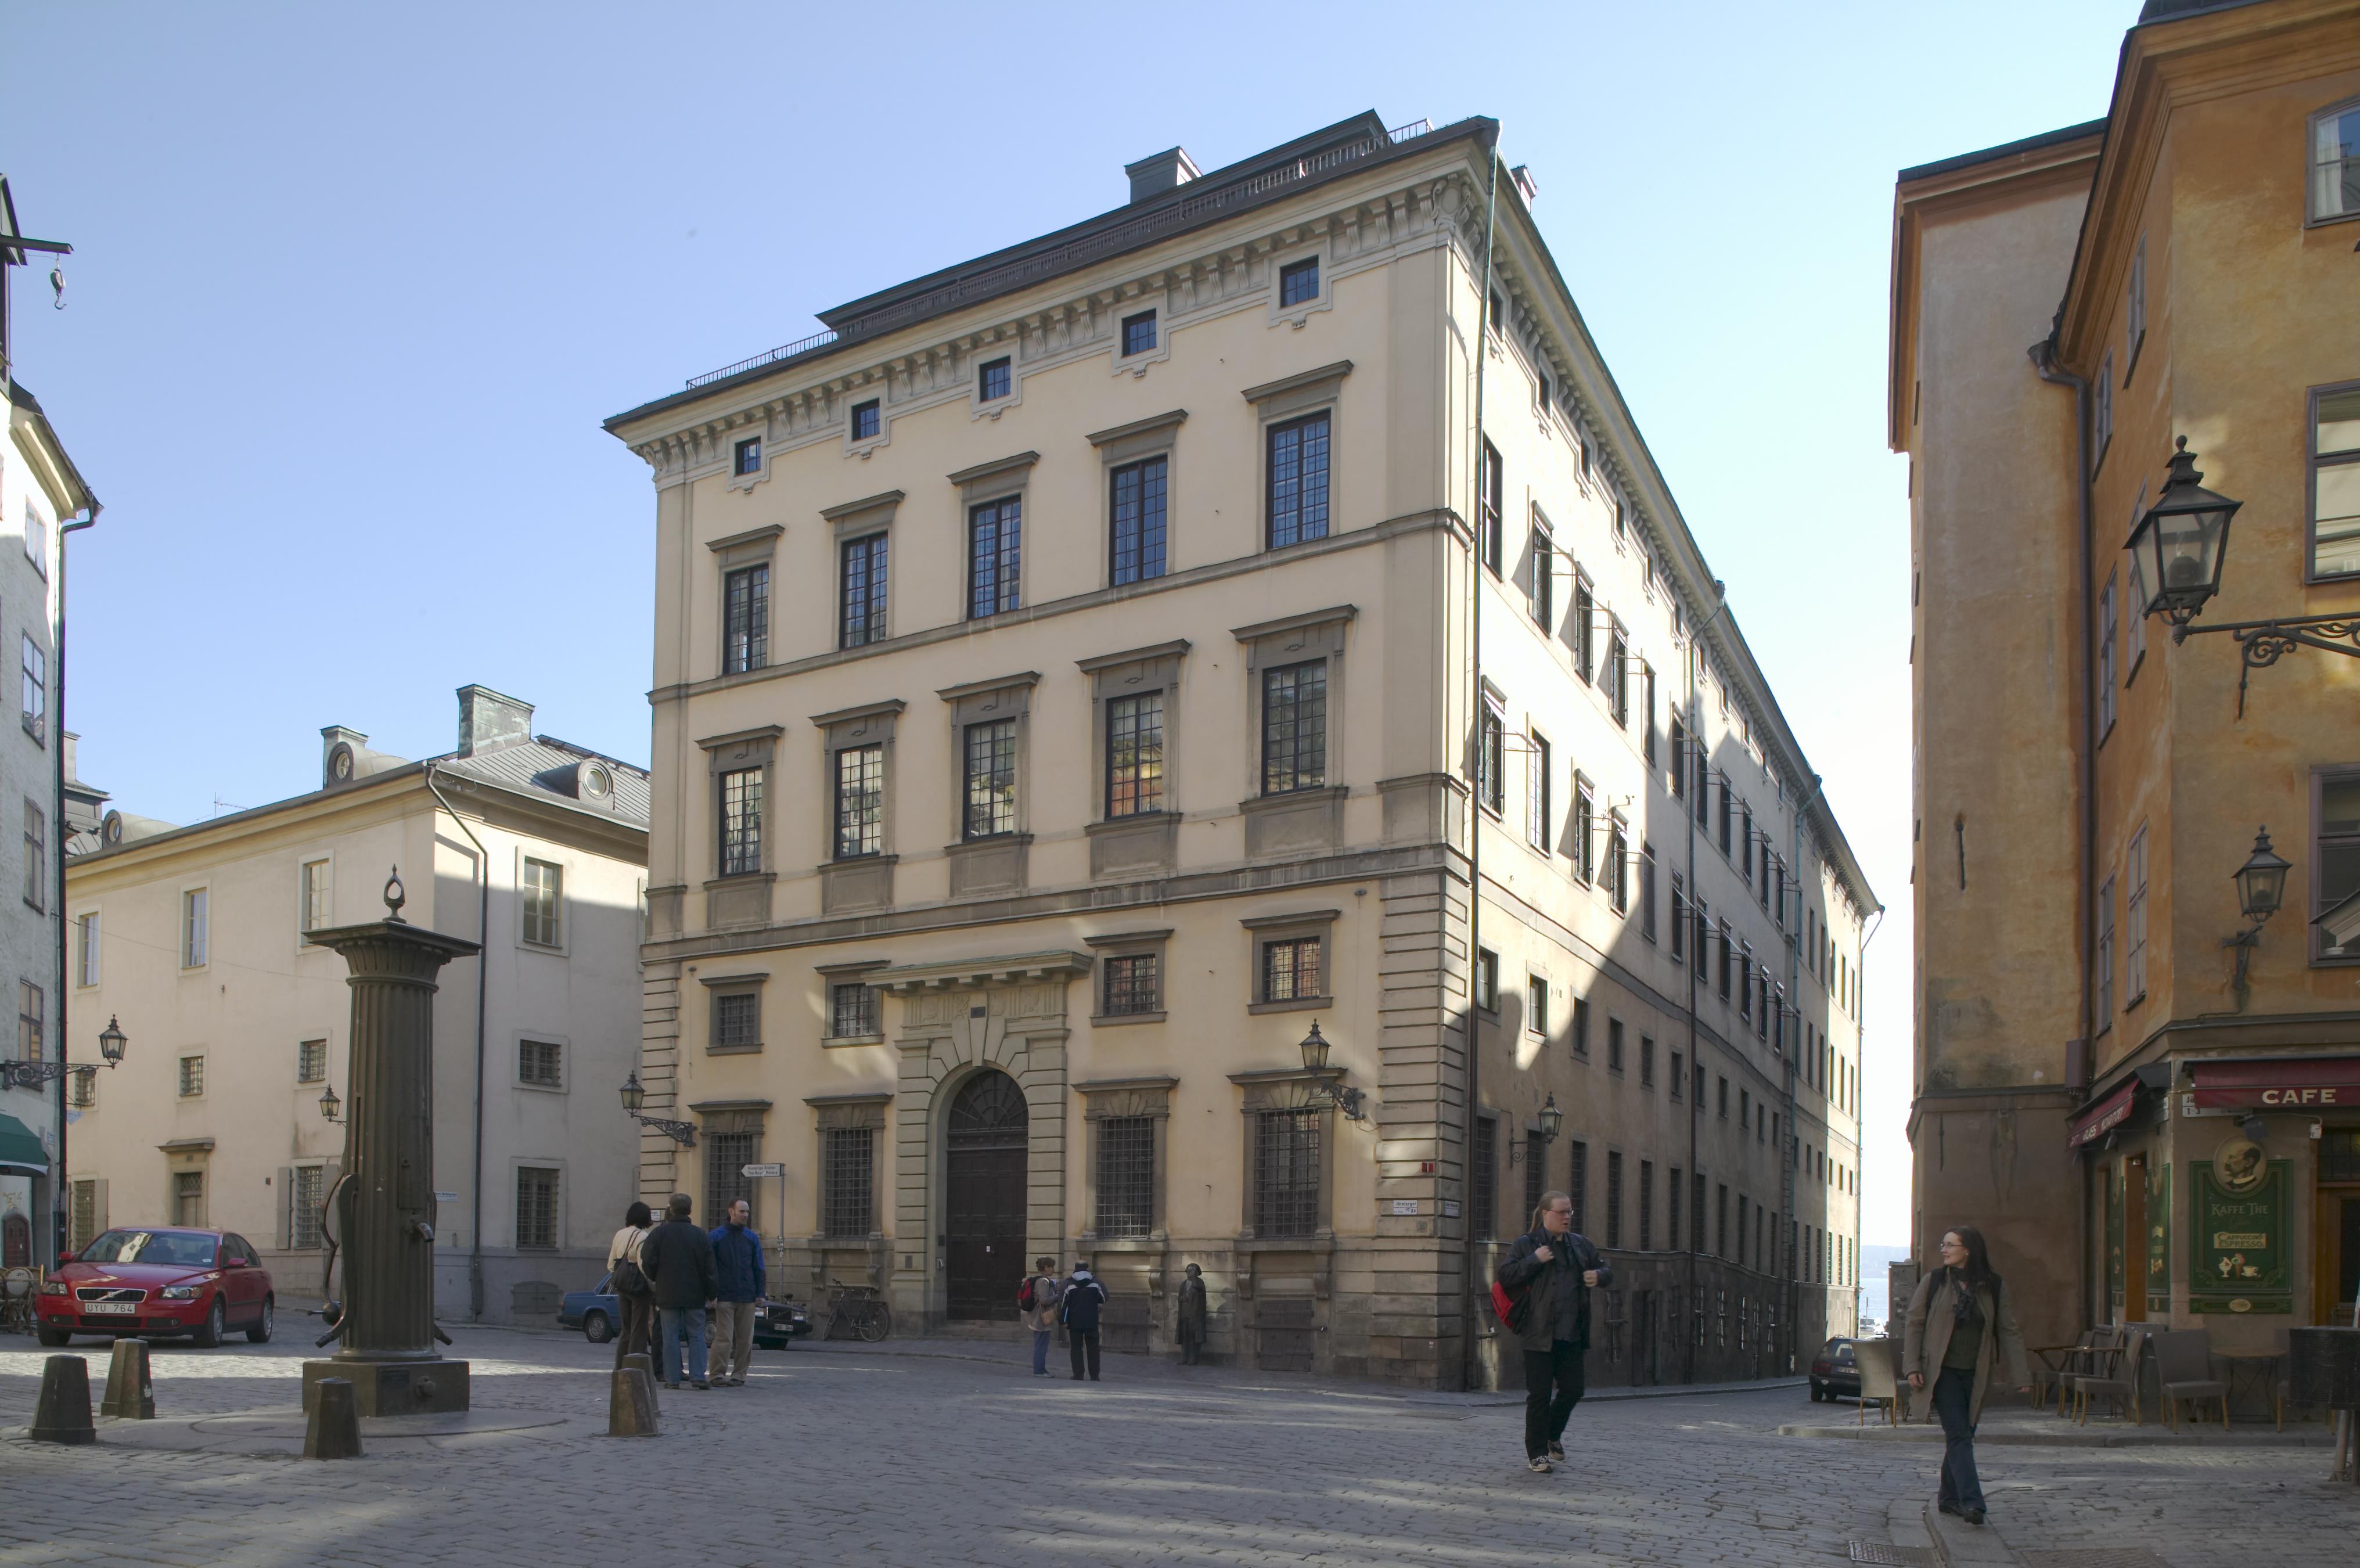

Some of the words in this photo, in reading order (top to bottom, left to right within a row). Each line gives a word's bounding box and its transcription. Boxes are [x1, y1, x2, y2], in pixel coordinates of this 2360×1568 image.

[2262, 1088, 2336, 1104] CAFE
[88, 1304, 106, 1312] UYU
[114, 1304, 132, 1312] 764
